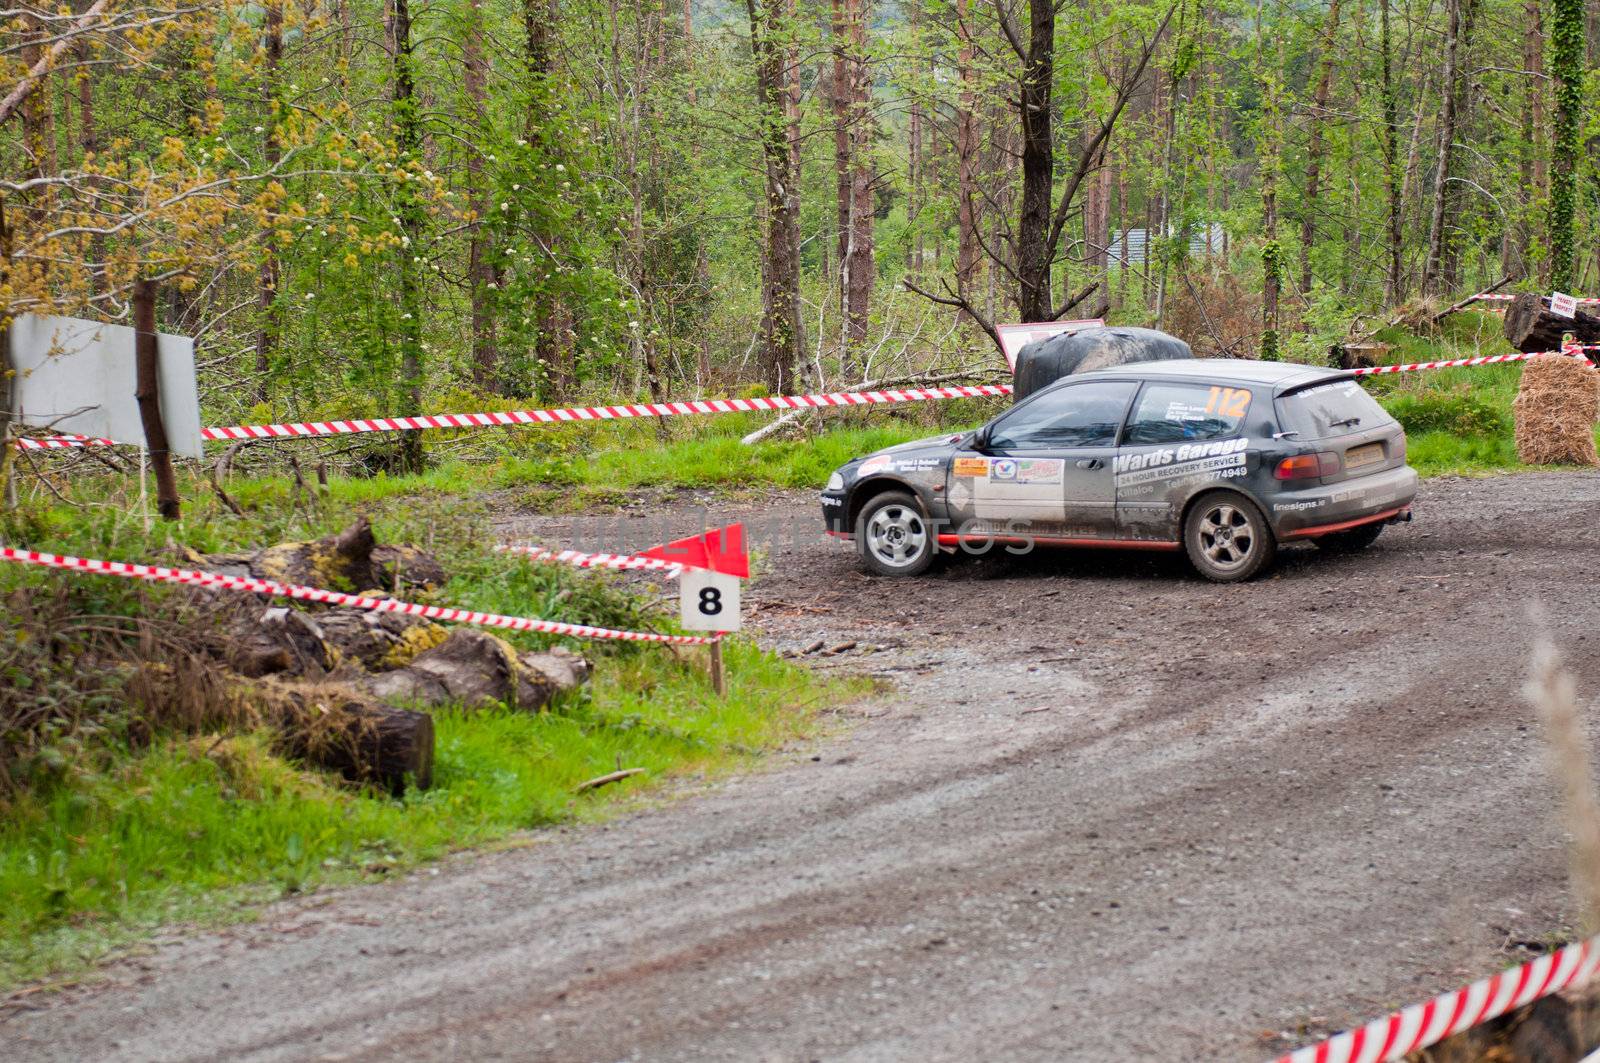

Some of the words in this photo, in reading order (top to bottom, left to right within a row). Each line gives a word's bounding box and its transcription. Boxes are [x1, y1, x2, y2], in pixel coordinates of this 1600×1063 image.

[1204, 386, 1251, 417] 112
[1112, 448, 1174, 473] Wards
[1176, 438, 1249, 461] Garage
[1120, 476, 1130, 485] 24
[1132, 471, 1156, 483] HOUR
[1157, 464, 1201, 478] RECOVERY
[1203, 456, 1239, 469] SERVICE
[1273, 499, 1326, 511] finesigns.ie
[697, 586, 723, 616] 8
